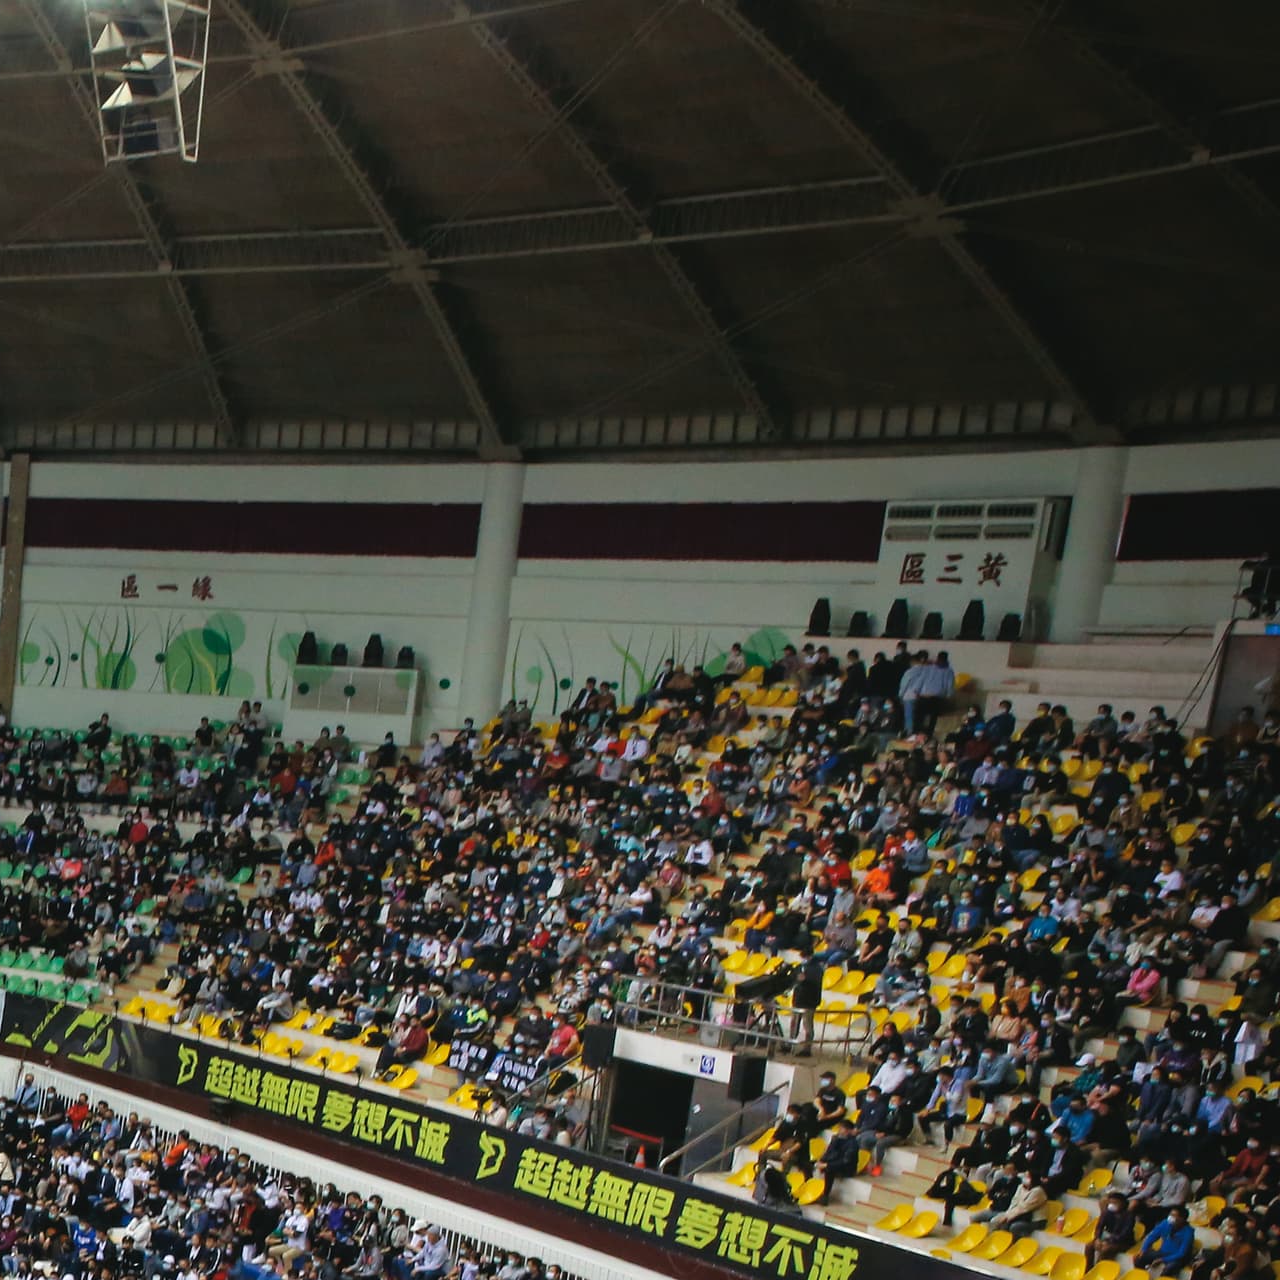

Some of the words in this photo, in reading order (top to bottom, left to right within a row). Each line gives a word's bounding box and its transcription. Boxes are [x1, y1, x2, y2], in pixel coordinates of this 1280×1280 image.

[203, 1054, 318, 1125] 超越無限
[321, 1091, 452, 1166] 夢想不滅
[513, 1146, 676, 1238] 超越無限
